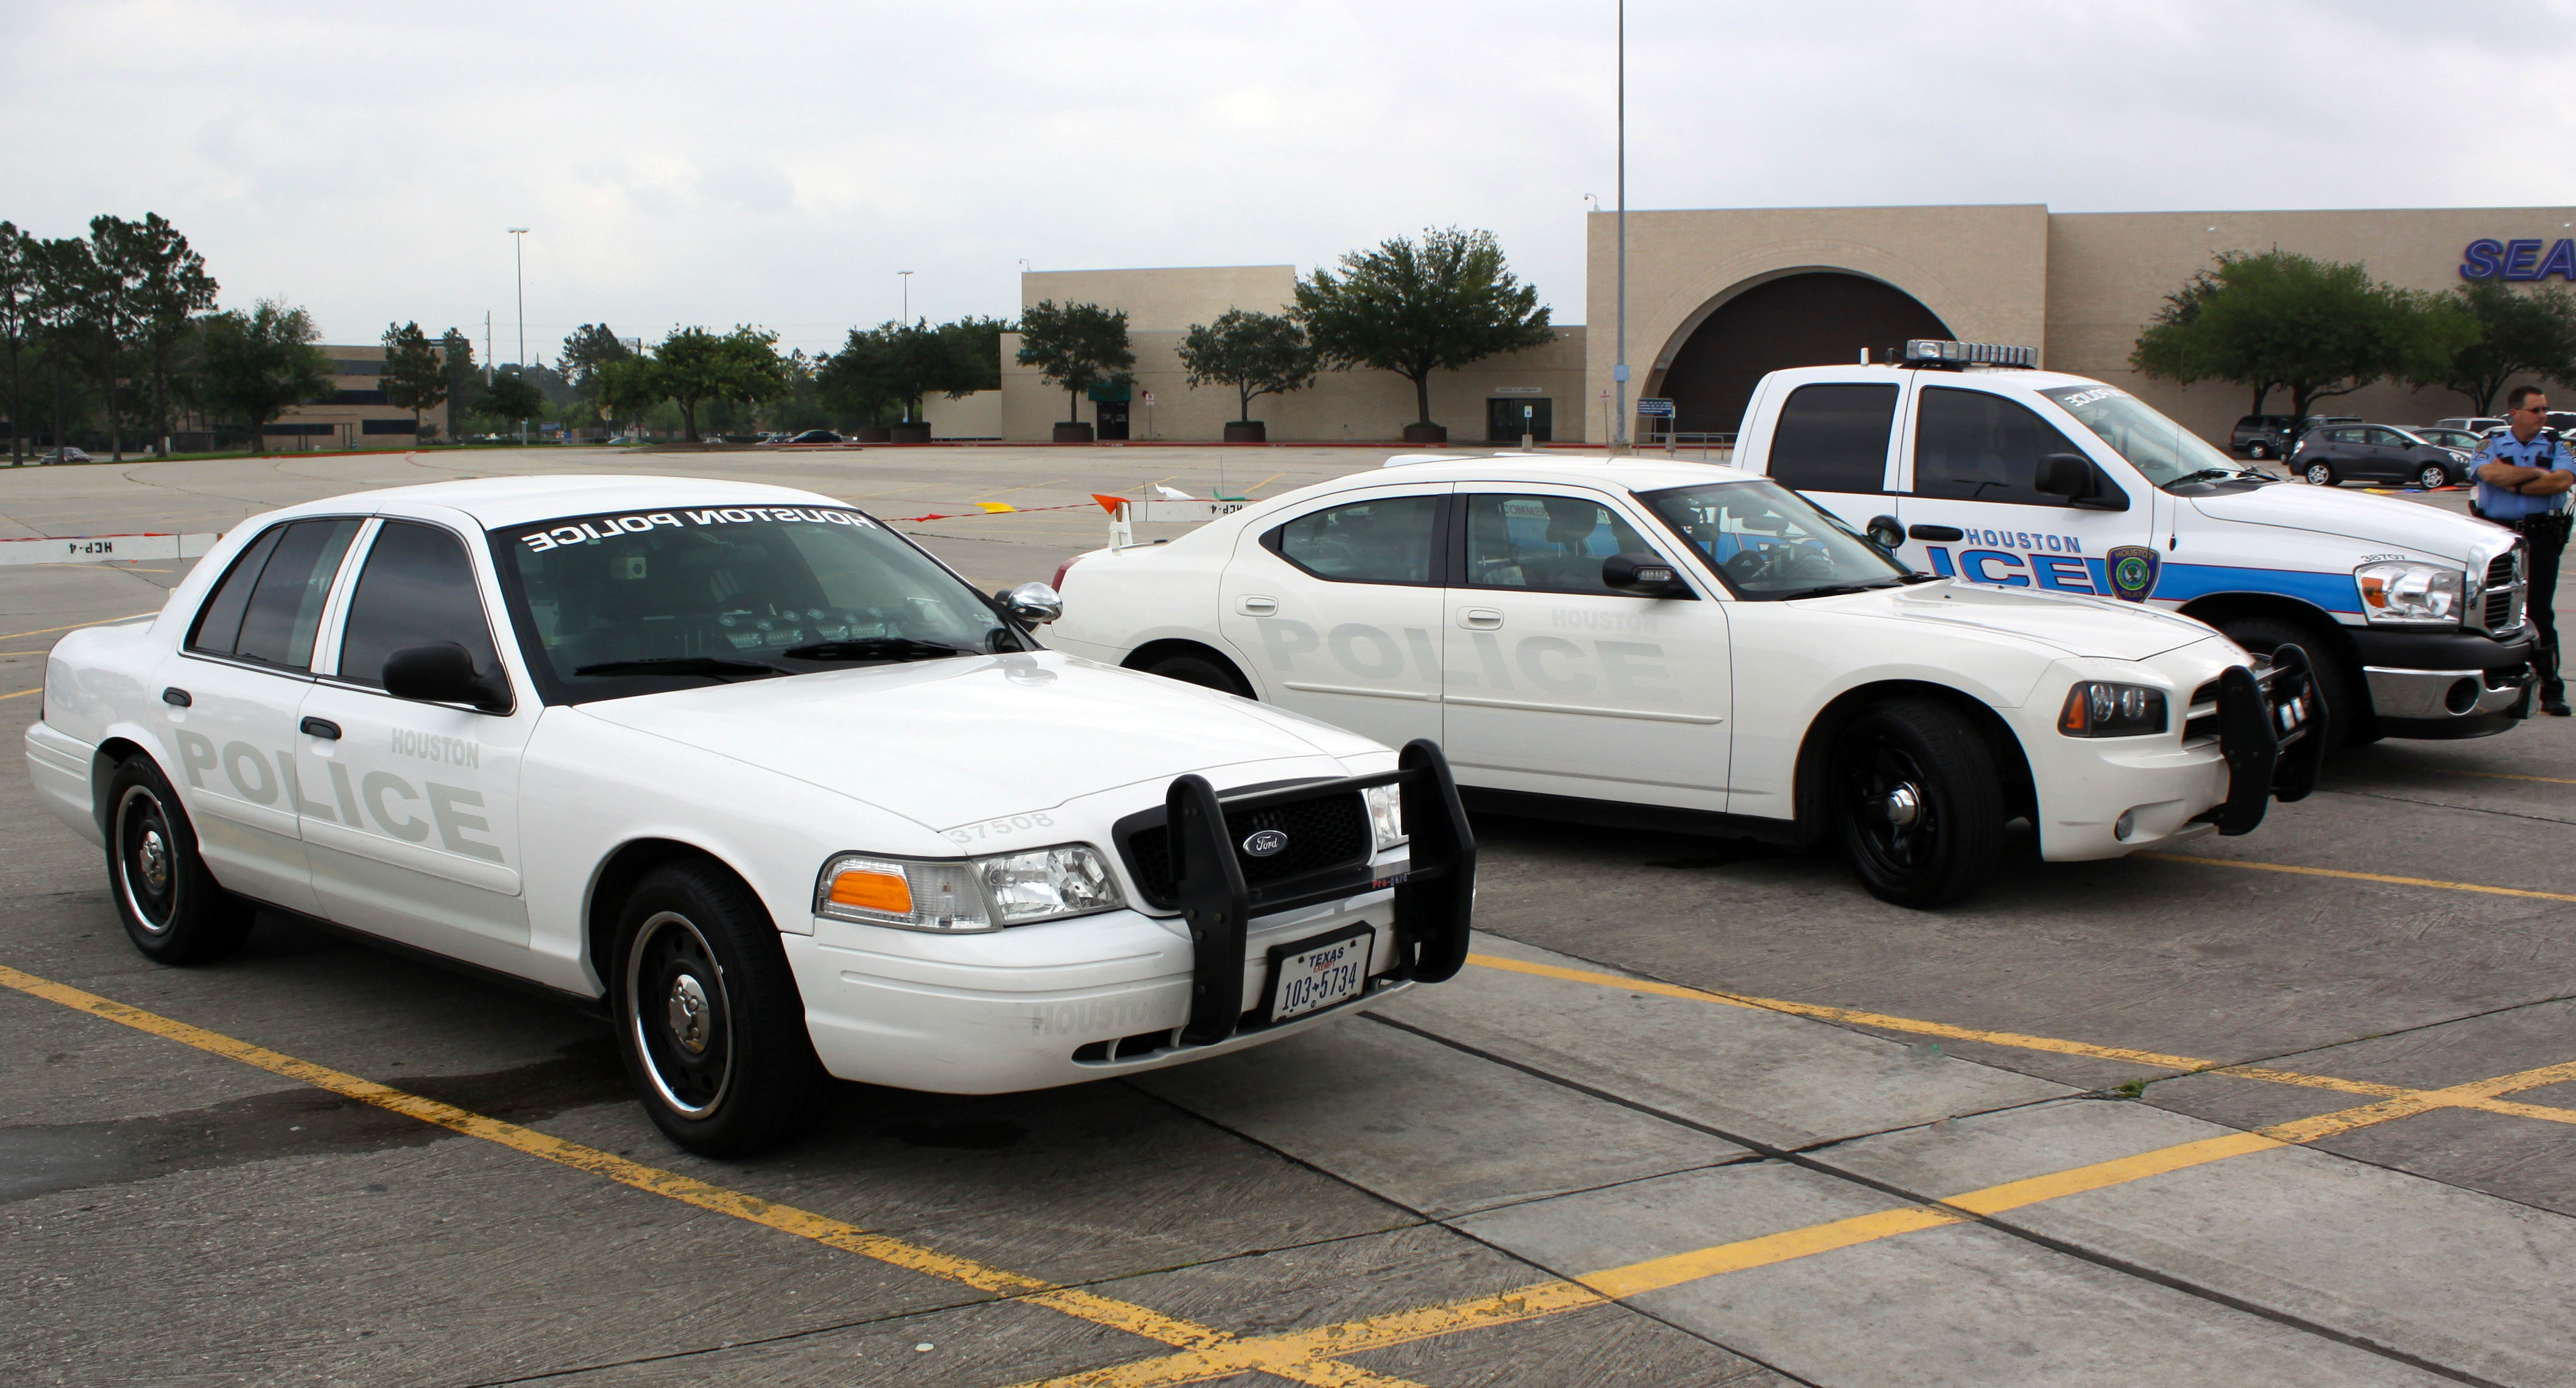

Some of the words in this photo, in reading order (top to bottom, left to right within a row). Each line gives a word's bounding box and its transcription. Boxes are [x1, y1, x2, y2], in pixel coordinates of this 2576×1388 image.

[69, 541, 112, 554] HCP-4
[1964, 529, 2081, 553] HOUSTON
[1551, 608, 1659, 633] HOUSTON
[1255, 617, 1682, 703] POLICE
[390, 727, 480, 769] HOUSTON
[175, 728, 506, 864] POLICE
[949, 813, 1055, 844] 37508
[1256, 835, 1278, 851] Ford
[1310, 947, 1344, 968] TEXAS
[1313, 960, 1336, 973] EXEMPT
[1031, 993, 1166, 1037] HOUSTON
